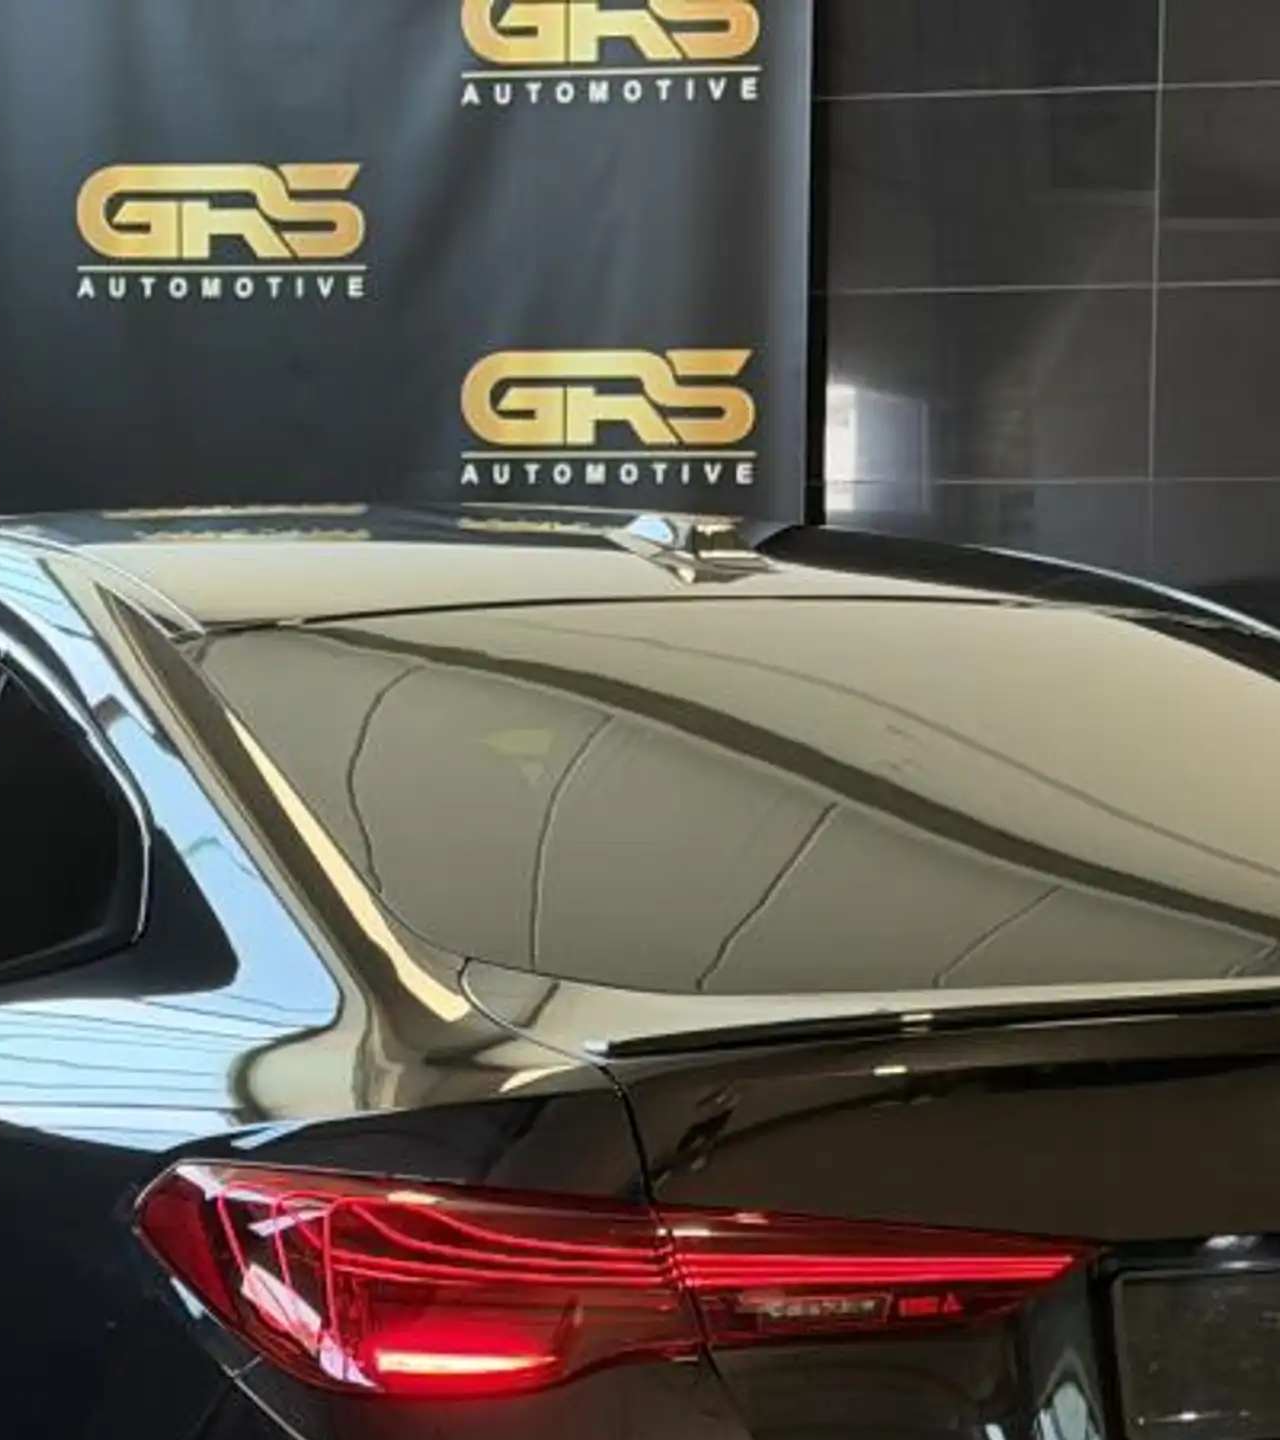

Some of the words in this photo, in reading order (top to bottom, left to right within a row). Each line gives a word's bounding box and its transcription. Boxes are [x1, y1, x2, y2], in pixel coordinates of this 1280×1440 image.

[461, 0, 760, 63] GRS
[461, 77, 757, 105] AUTOMOTIVE
[76, 163, 365, 259] GRS
[77, 276, 364, 299] AUTOMOTIVE
[461, 348, 756, 447] GRS
[461, 463, 754, 486] AUTOMOTIVE
